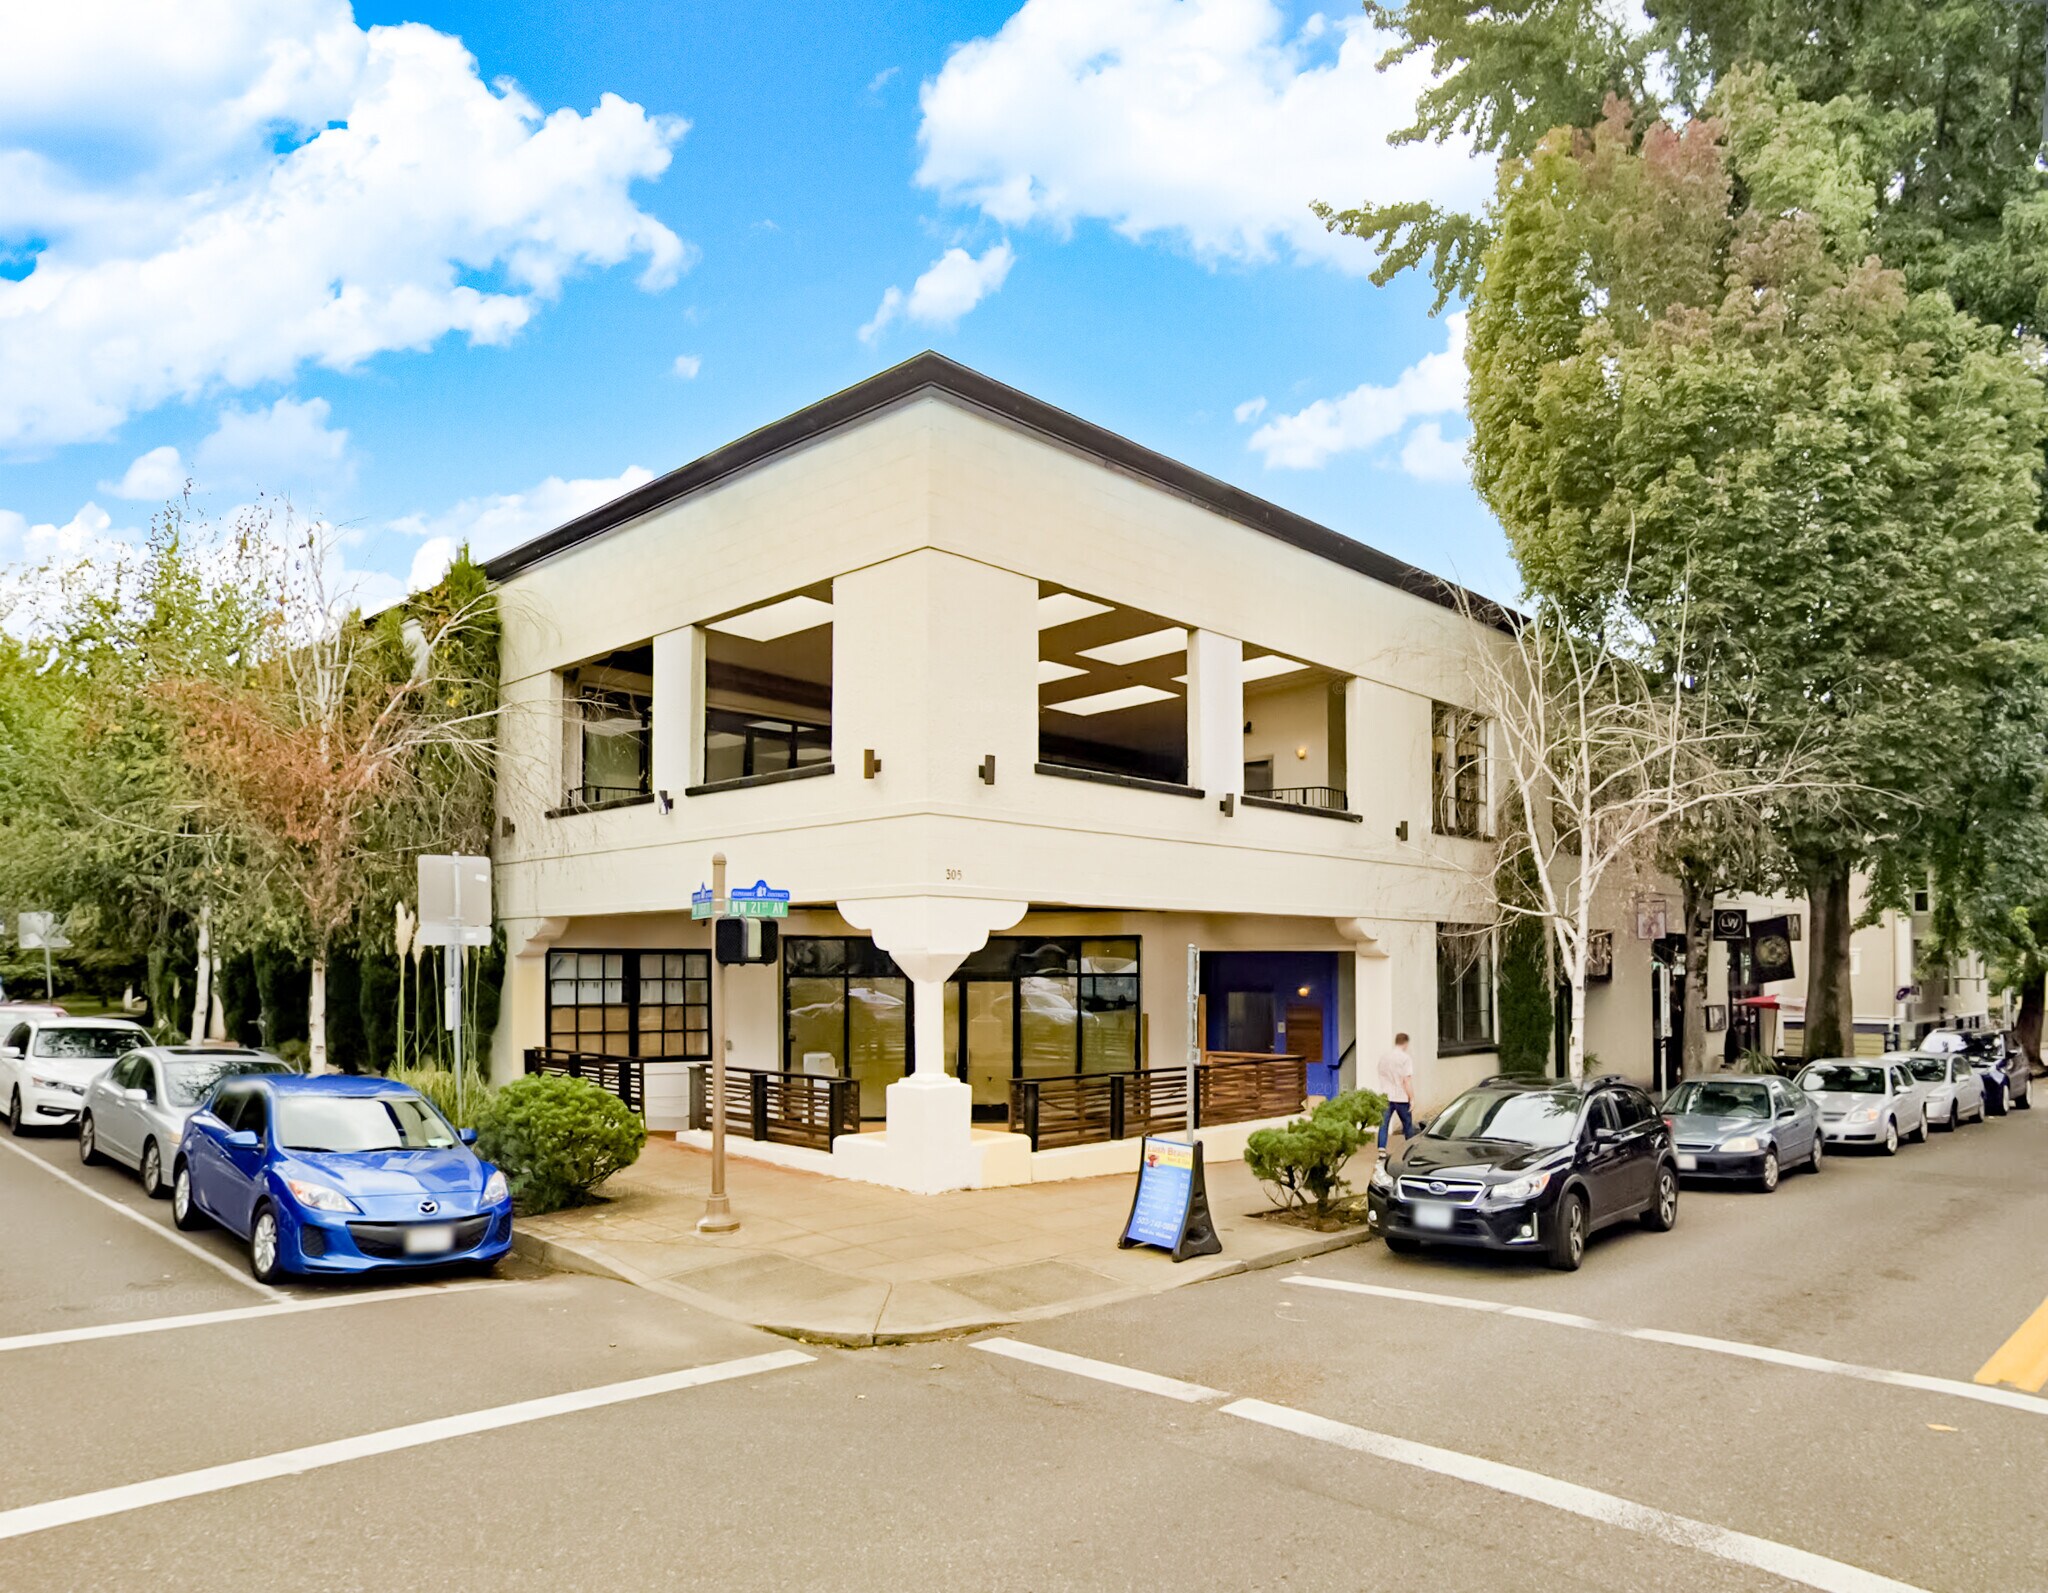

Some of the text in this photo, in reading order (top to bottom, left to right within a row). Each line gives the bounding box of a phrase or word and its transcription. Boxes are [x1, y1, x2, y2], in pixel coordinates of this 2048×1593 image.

[946, 868, 962, 880] 305
[732, 901, 747, 914] NW
[772, 902, 785, 915] AV
